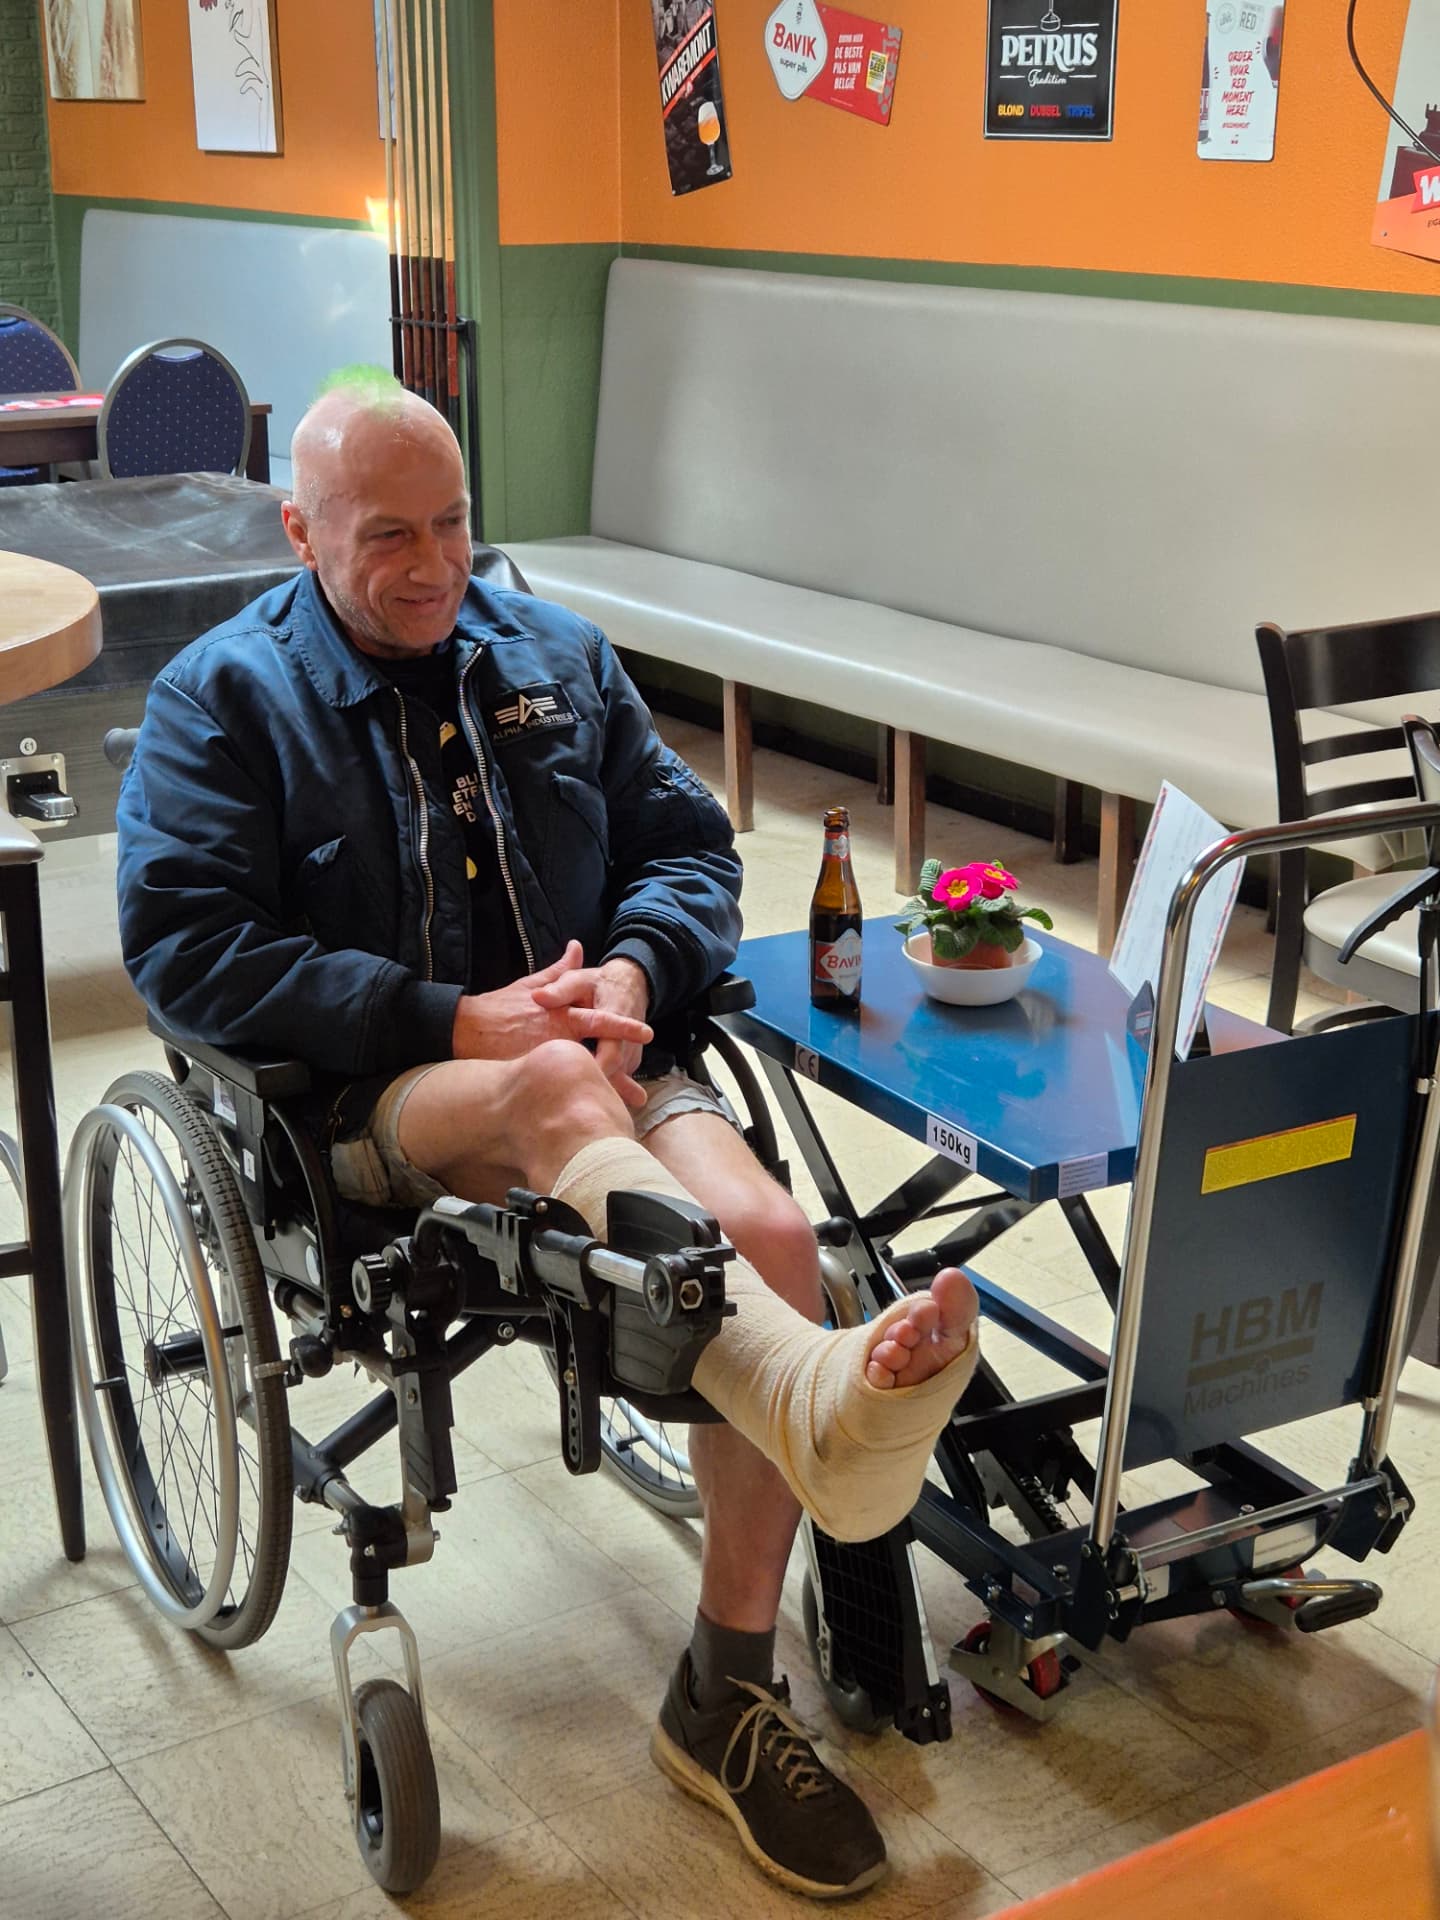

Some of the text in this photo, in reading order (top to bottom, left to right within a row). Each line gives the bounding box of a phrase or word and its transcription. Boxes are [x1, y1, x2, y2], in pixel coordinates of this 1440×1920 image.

[773, 22, 817, 61] BAVIK
[1001, 32, 1099, 72] PETRUS
[1228, 50, 1252, 62] ORDER
[660, 21, 711, 106] KWAREMONT
[1028, 69, 1067, 87] Tradition
[1230, 64, 1249, 76] YOUR
[998, 104, 1024, 116] BLOND
[1222, 90, 1254, 103] MOMENT
[932, 1125, 971, 1165] 150kg
[1190, 1281, 1324, 1362] HBM
[1183, 1362, 1313, 1418] Machines
